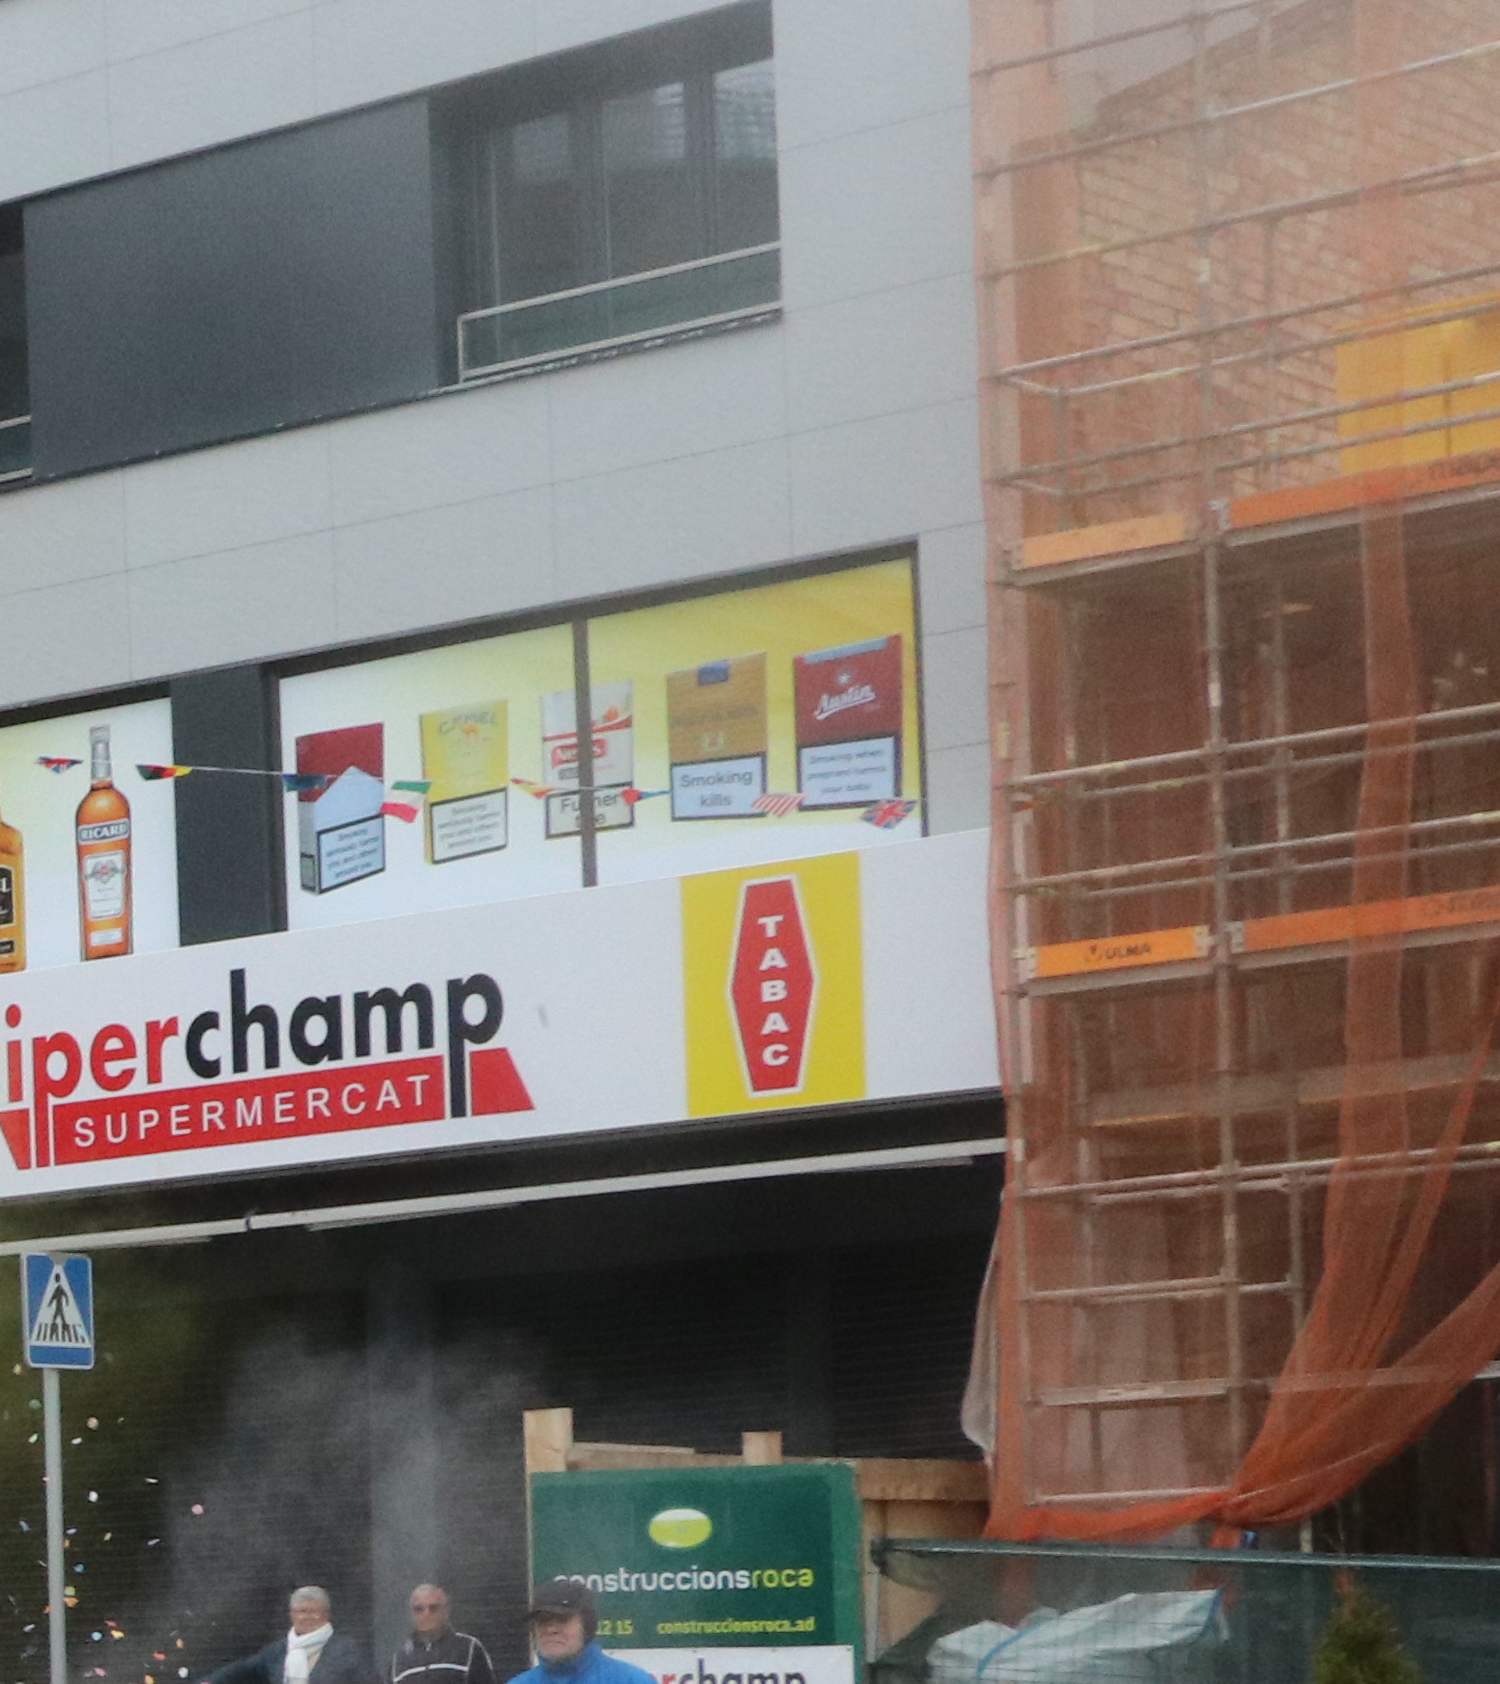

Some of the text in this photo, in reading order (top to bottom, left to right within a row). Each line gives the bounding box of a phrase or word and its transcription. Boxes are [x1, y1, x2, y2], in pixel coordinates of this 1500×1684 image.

[681, 771, 753, 788] Smoking
[700, 793, 732, 807] kills
[80, 823, 128, 840] RICARD
[757, 914, 790, 1067] TABAC
[74, 1074, 431, 1148] SUPERMERCAT
[616, 1619, 634, 1636] 15
[656, 1615, 816, 1636] construccionsroca.ad
